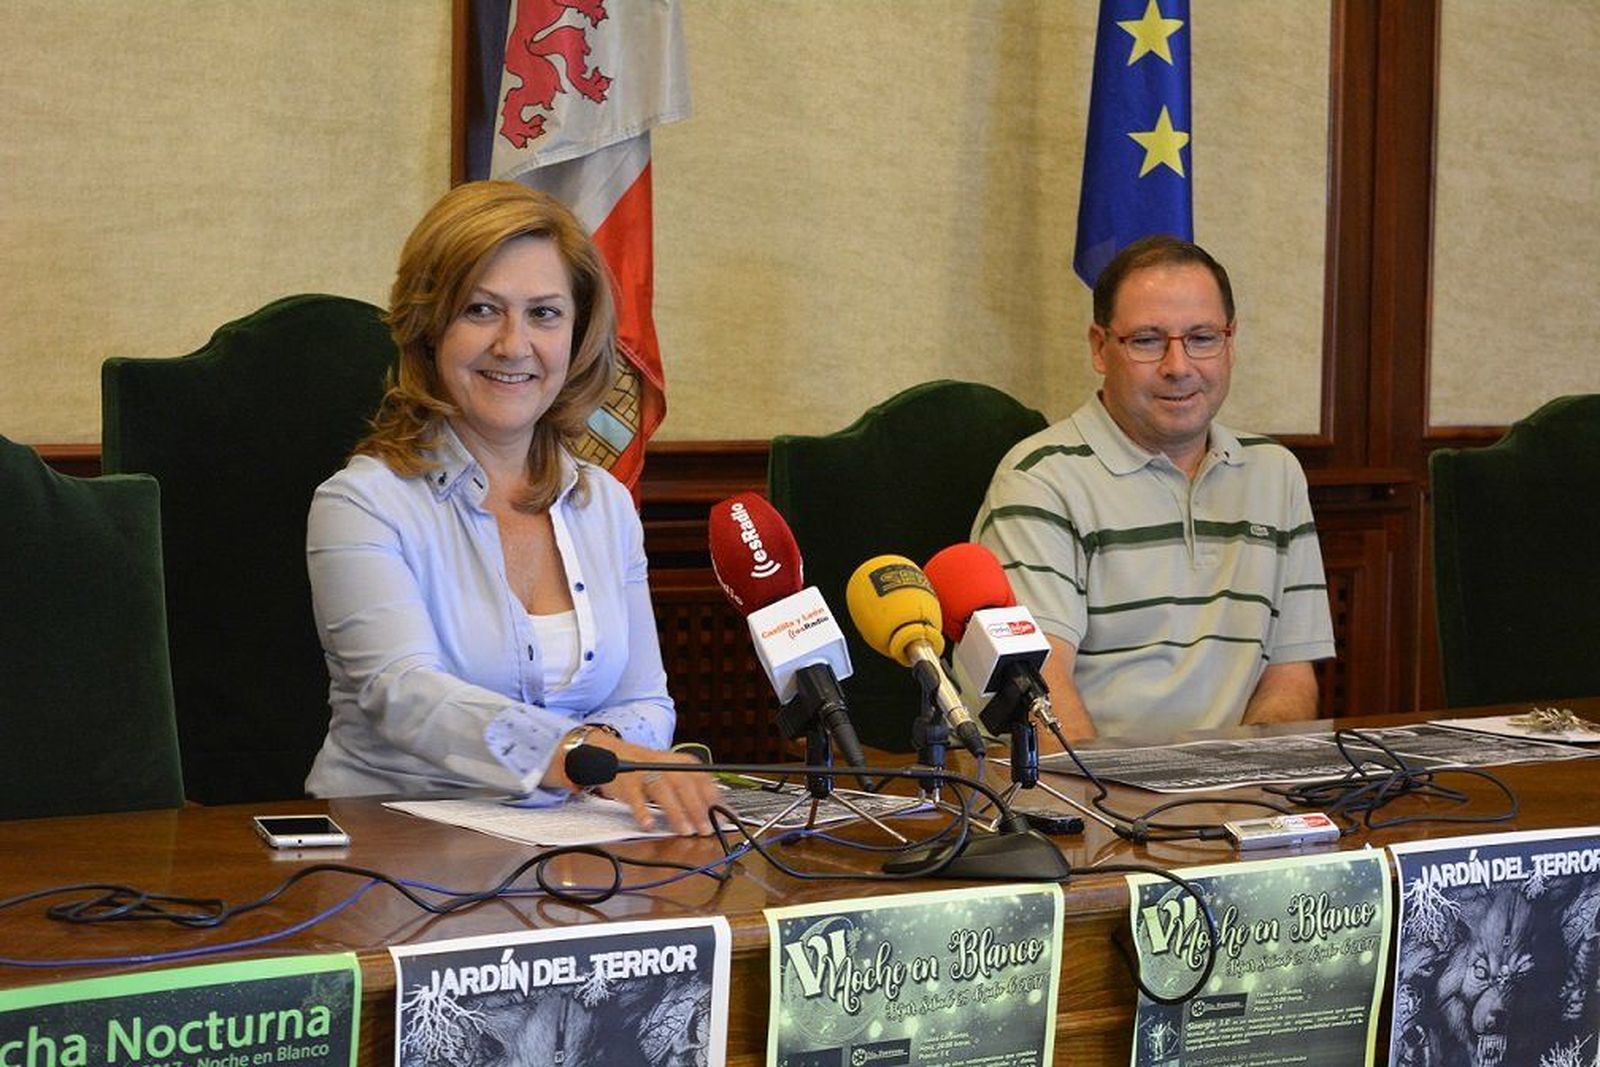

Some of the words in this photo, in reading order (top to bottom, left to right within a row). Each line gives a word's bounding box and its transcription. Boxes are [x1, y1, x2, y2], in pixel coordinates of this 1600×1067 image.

[731, 502, 768, 562] esRadio
[1420, 849, 1490, 889] JARDÍN
[1492, 856, 1530, 882] DEL
[1255, 919, 1279, 943] en
[1287, 891, 1376, 941] Blanco
[424, 949, 529, 997] JARDÍN
[532, 956, 588, 988] DEL
[588, 944, 698, 981] TERROR
[786, 928, 848, 998] VI
[823, 943, 906, 1013] Noche
[911, 956, 938, 983] en
[949, 927, 1043, 980] Blanco
[106, 1004, 331, 1063] Nocturna
[253, 1050, 273, 1066] en
[277, 1042, 330, 1061] Blanco
